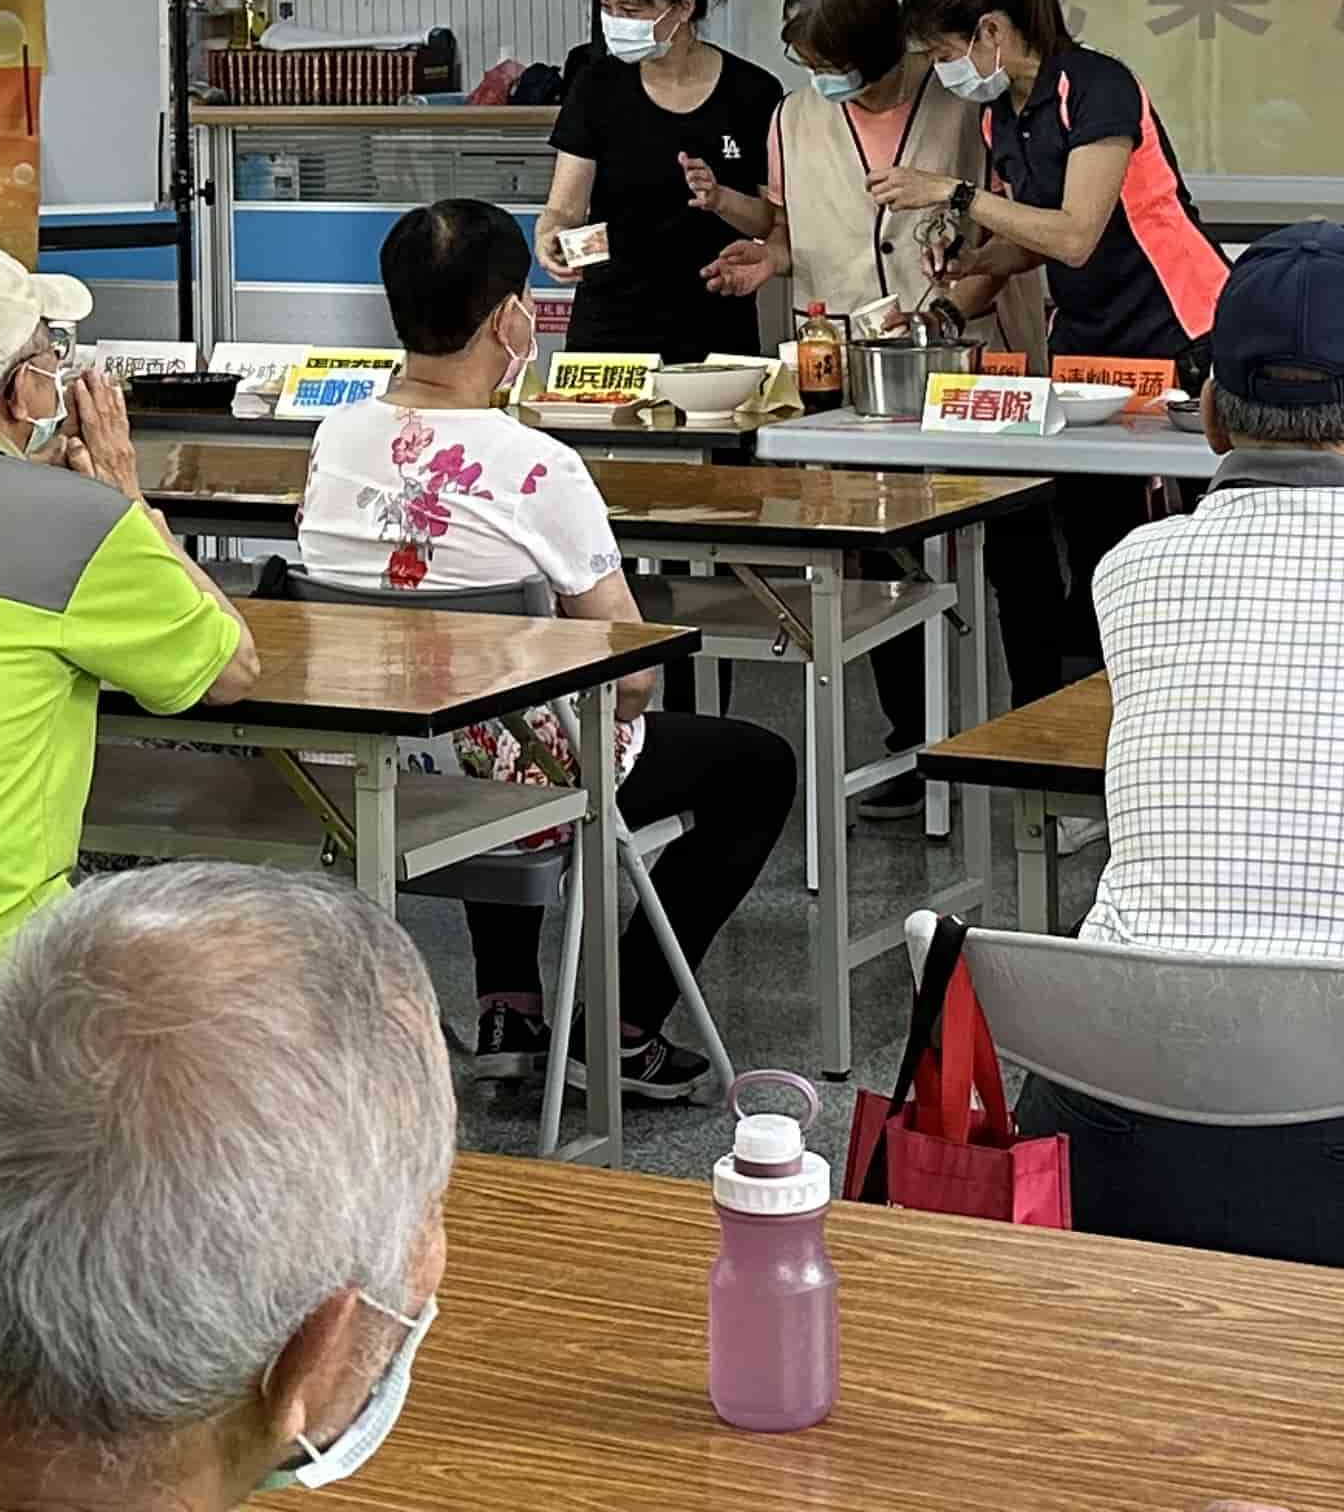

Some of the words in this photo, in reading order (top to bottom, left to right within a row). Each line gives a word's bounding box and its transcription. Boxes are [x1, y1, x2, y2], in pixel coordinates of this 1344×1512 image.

[721, 135, 742, 159] LA
[555, 364, 648, 390] 蝦兵蝦將
[939, 388, 1033, 424] 青春隊
